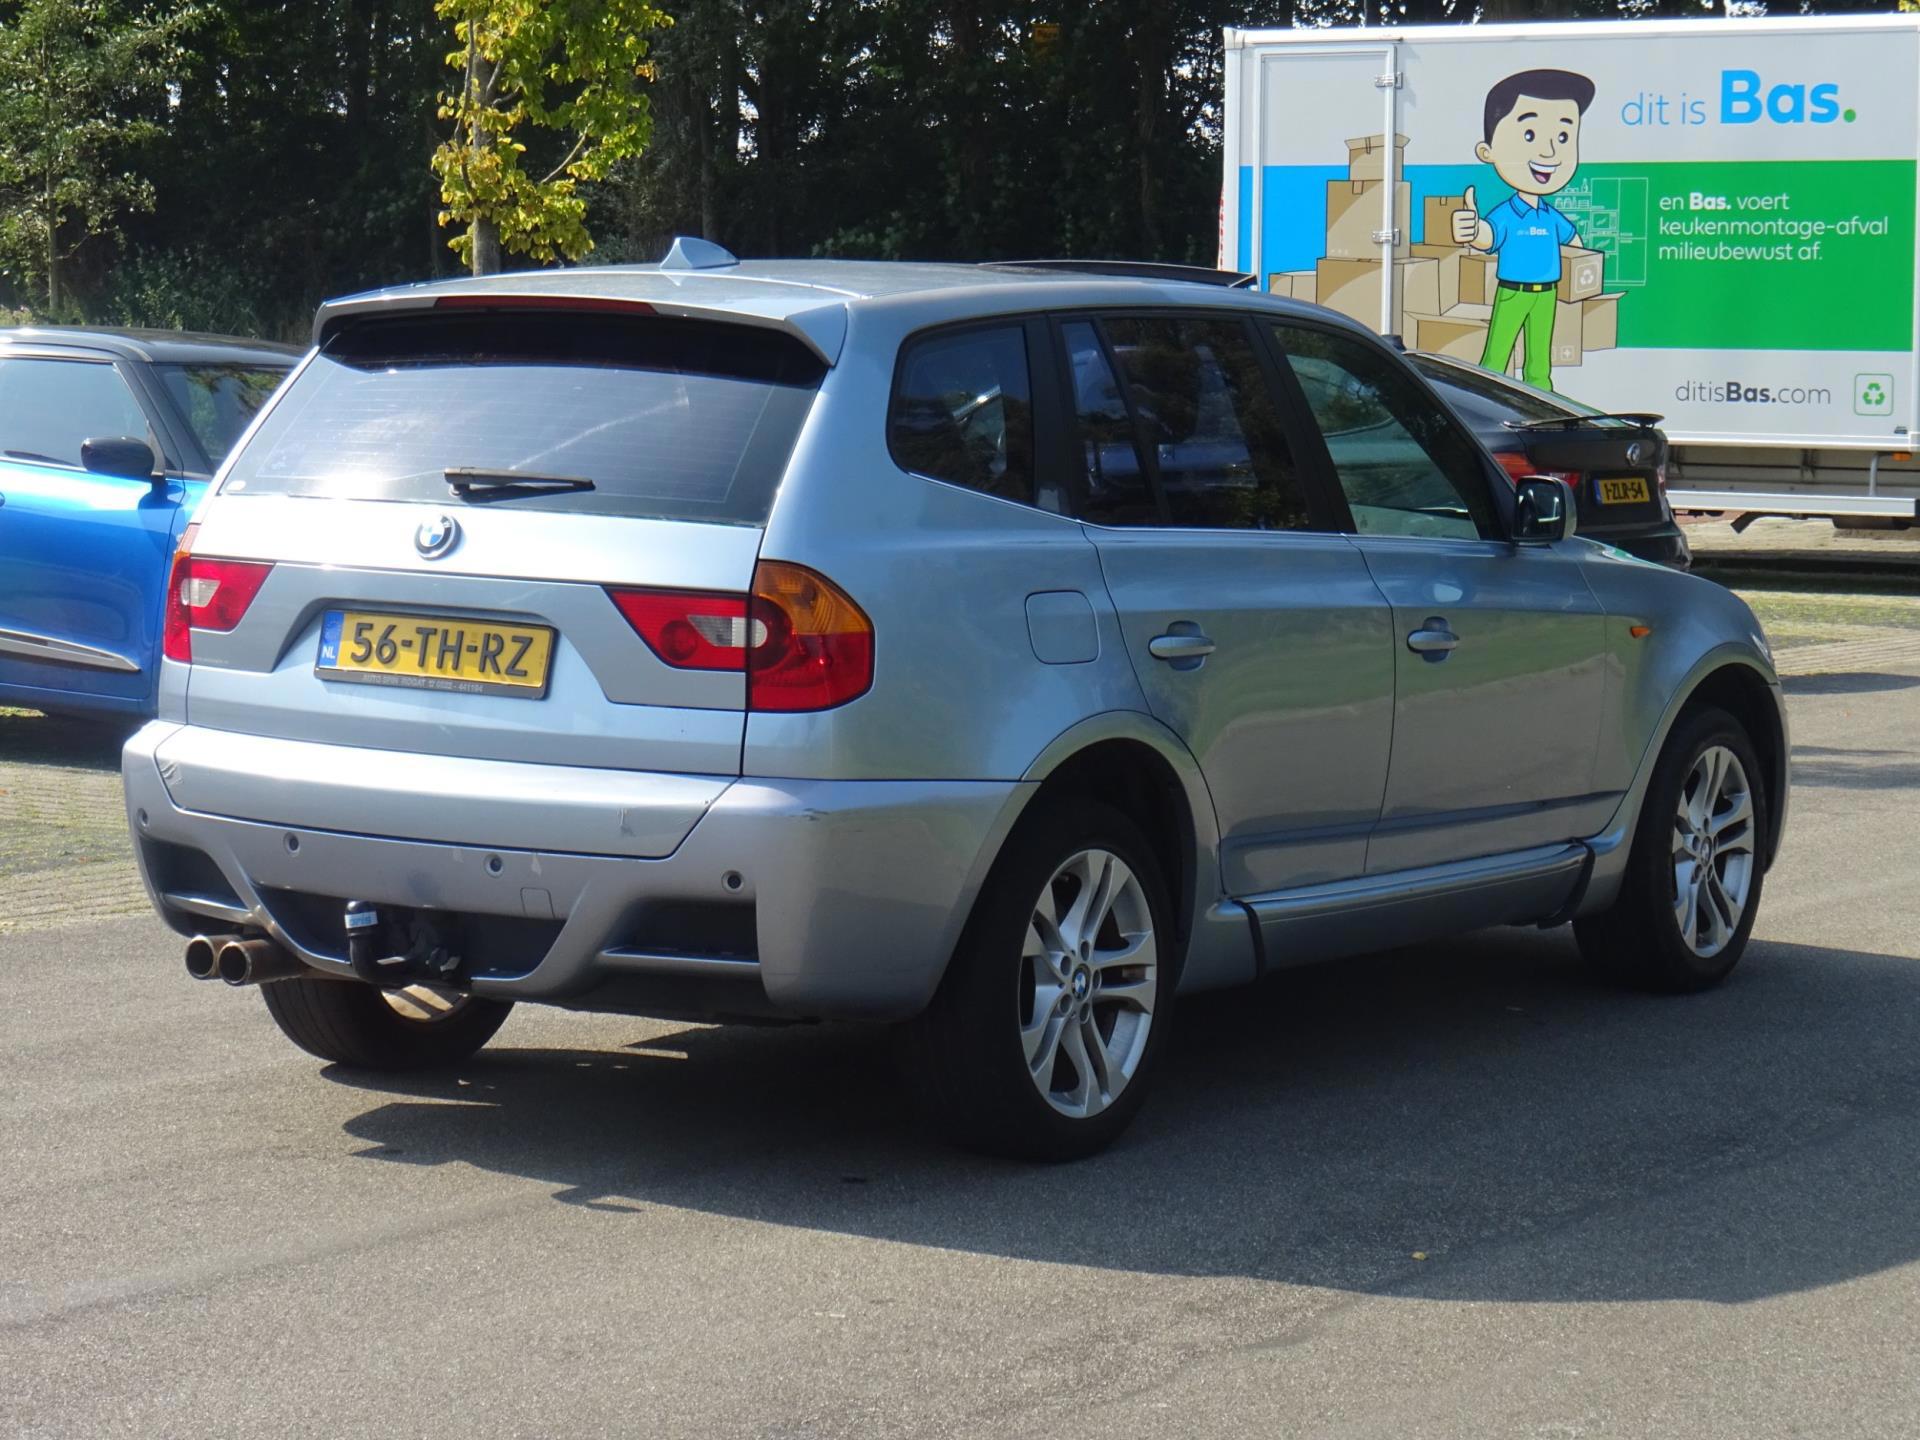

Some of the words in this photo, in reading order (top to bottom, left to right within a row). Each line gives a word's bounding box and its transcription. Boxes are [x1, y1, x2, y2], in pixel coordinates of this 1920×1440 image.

[1620, 92, 1670, 126] dit
[1681, 92, 1707, 126] is
[1719, 69, 1857, 125] Bas.
[1658, 195, 1685, 211] en
[1689, 192, 1732, 211] Bas.
[1737, 192, 1790, 211] voert
[1658, 215, 1889, 240] keukenmontage-afval
[1658, 241, 1793, 261] milieubewust
[1797, 241, 1823, 261] af.
[1674, 380, 1832, 405] ditisBas.com
[321, 645, 336, 660] NL
[350, 622, 534, 677] 56-TH-RZ
